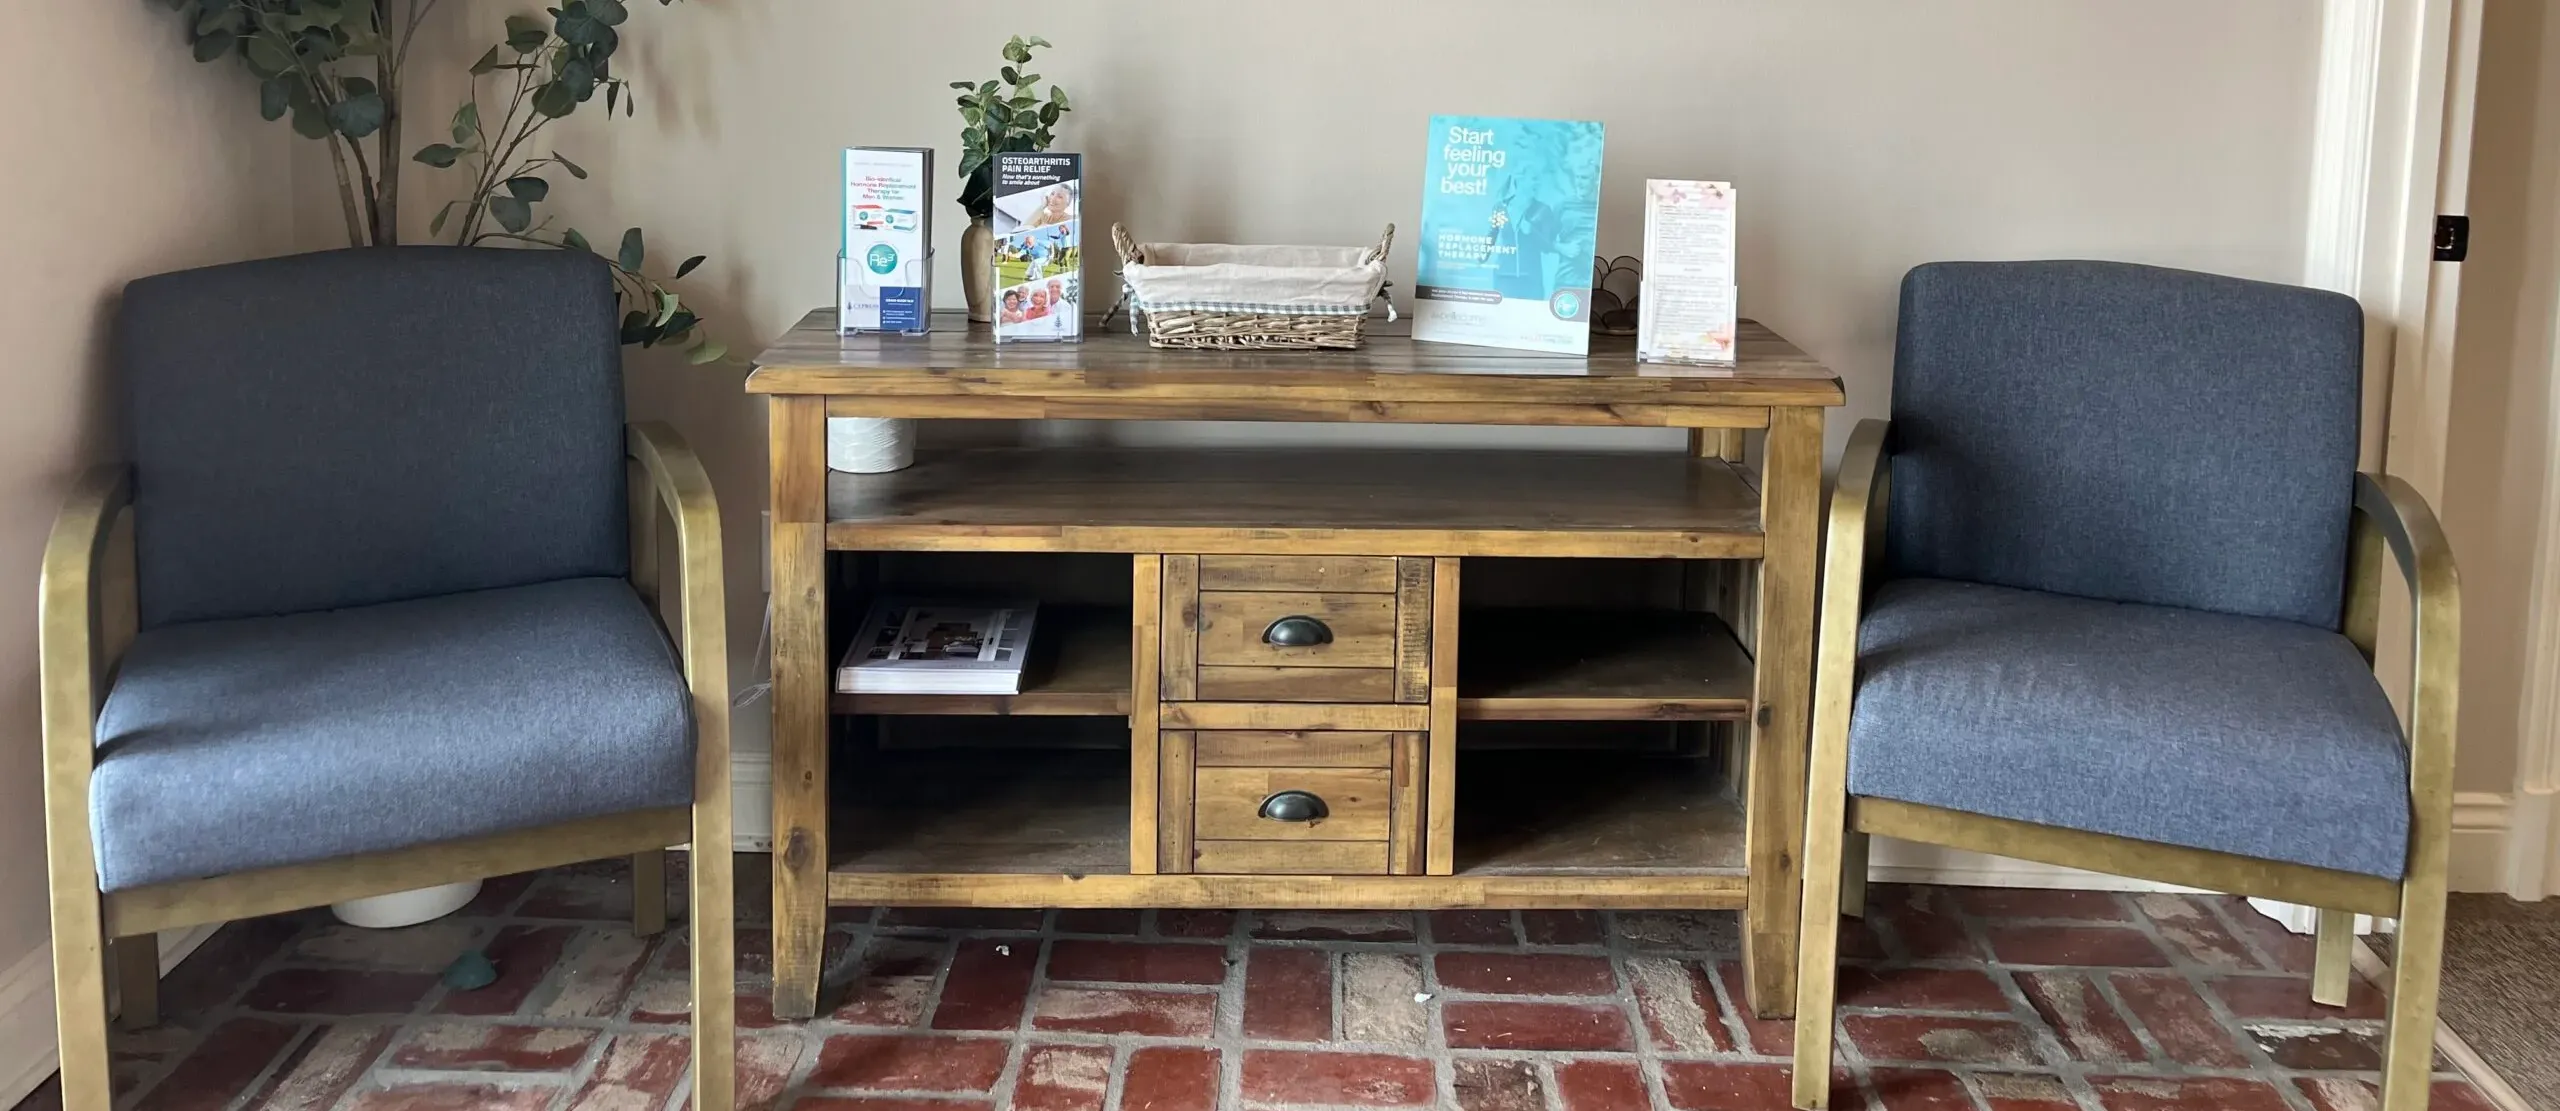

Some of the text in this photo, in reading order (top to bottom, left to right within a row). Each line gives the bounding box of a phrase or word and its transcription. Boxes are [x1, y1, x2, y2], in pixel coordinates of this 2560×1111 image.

[1448, 126, 1494, 145] Start
[1002, 157, 1071, 166] OSTEOARTHRITIS
[1444, 144, 1506, 168] feeling
[1023, 165, 1051, 173] RELIEF
[1448, 162, 1490, 180] your
[1441, 176, 1487, 195] best!
[1439, 234, 1493, 245] HORMONE
[1439, 242, 1517, 255] REPLACEMENT
[1439, 250, 1488, 261] THERAPY
